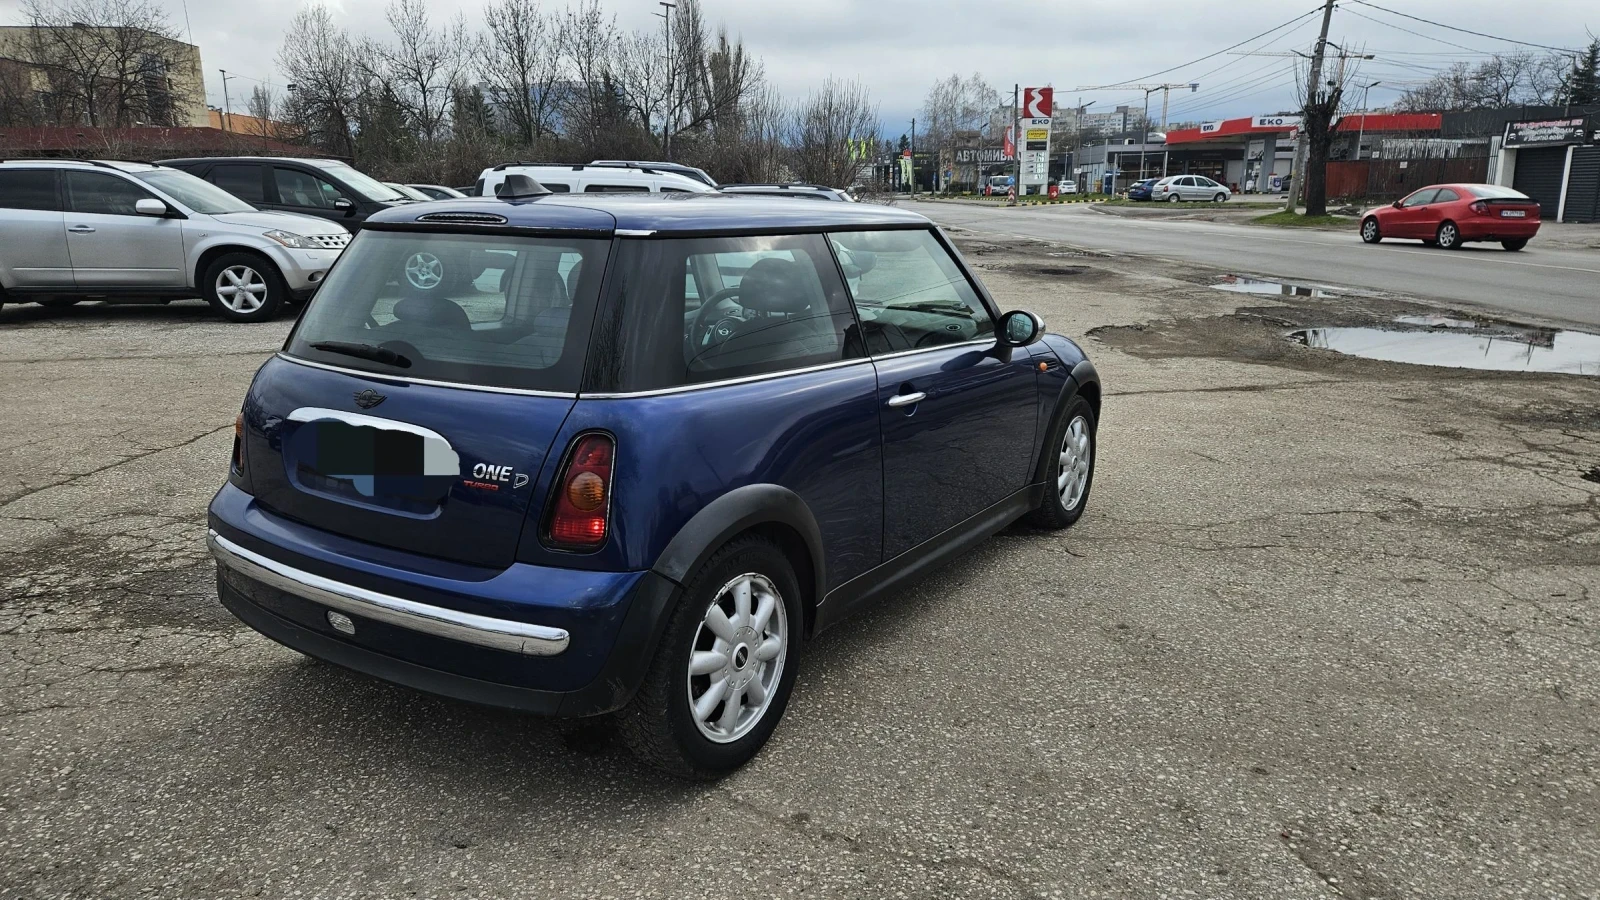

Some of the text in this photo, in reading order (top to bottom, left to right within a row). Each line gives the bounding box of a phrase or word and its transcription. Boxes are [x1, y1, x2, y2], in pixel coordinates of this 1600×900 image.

[1203, 124, 1214, 132] EKO
[472, 462, 513, 482] ONE
[463, 480, 499, 491] TURBO
